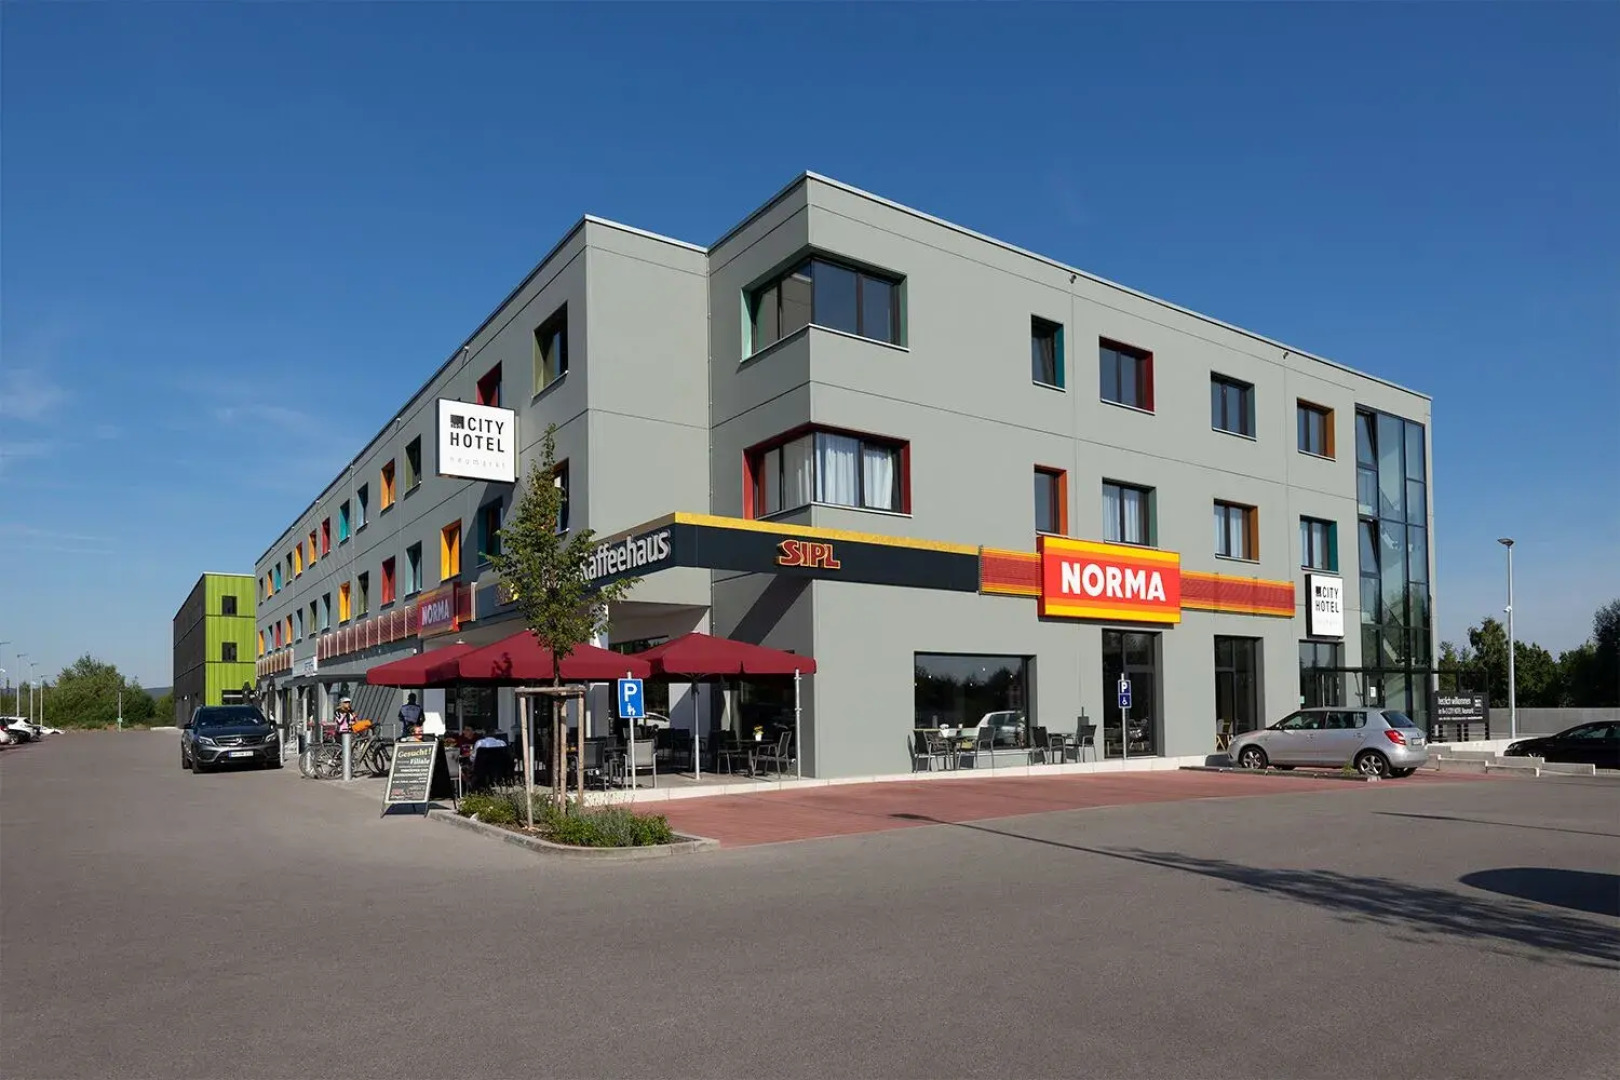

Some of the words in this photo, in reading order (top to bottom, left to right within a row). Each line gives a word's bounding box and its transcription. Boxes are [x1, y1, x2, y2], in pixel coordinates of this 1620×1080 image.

[467, 416, 504, 435] CITY
[450, 431, 505, 453] HOTEL
[778, 539, 841, 569] SIPL
[1061, 561, 1167, 602] NORMA
[1322, 586, 1339, 599] CITY
[421, 599, 450, 626] NORMA
[1315, 600, 1340, 613] HOTEL
[624, 683, 638, 702] P
[1121, 681, 1128, 693] P
